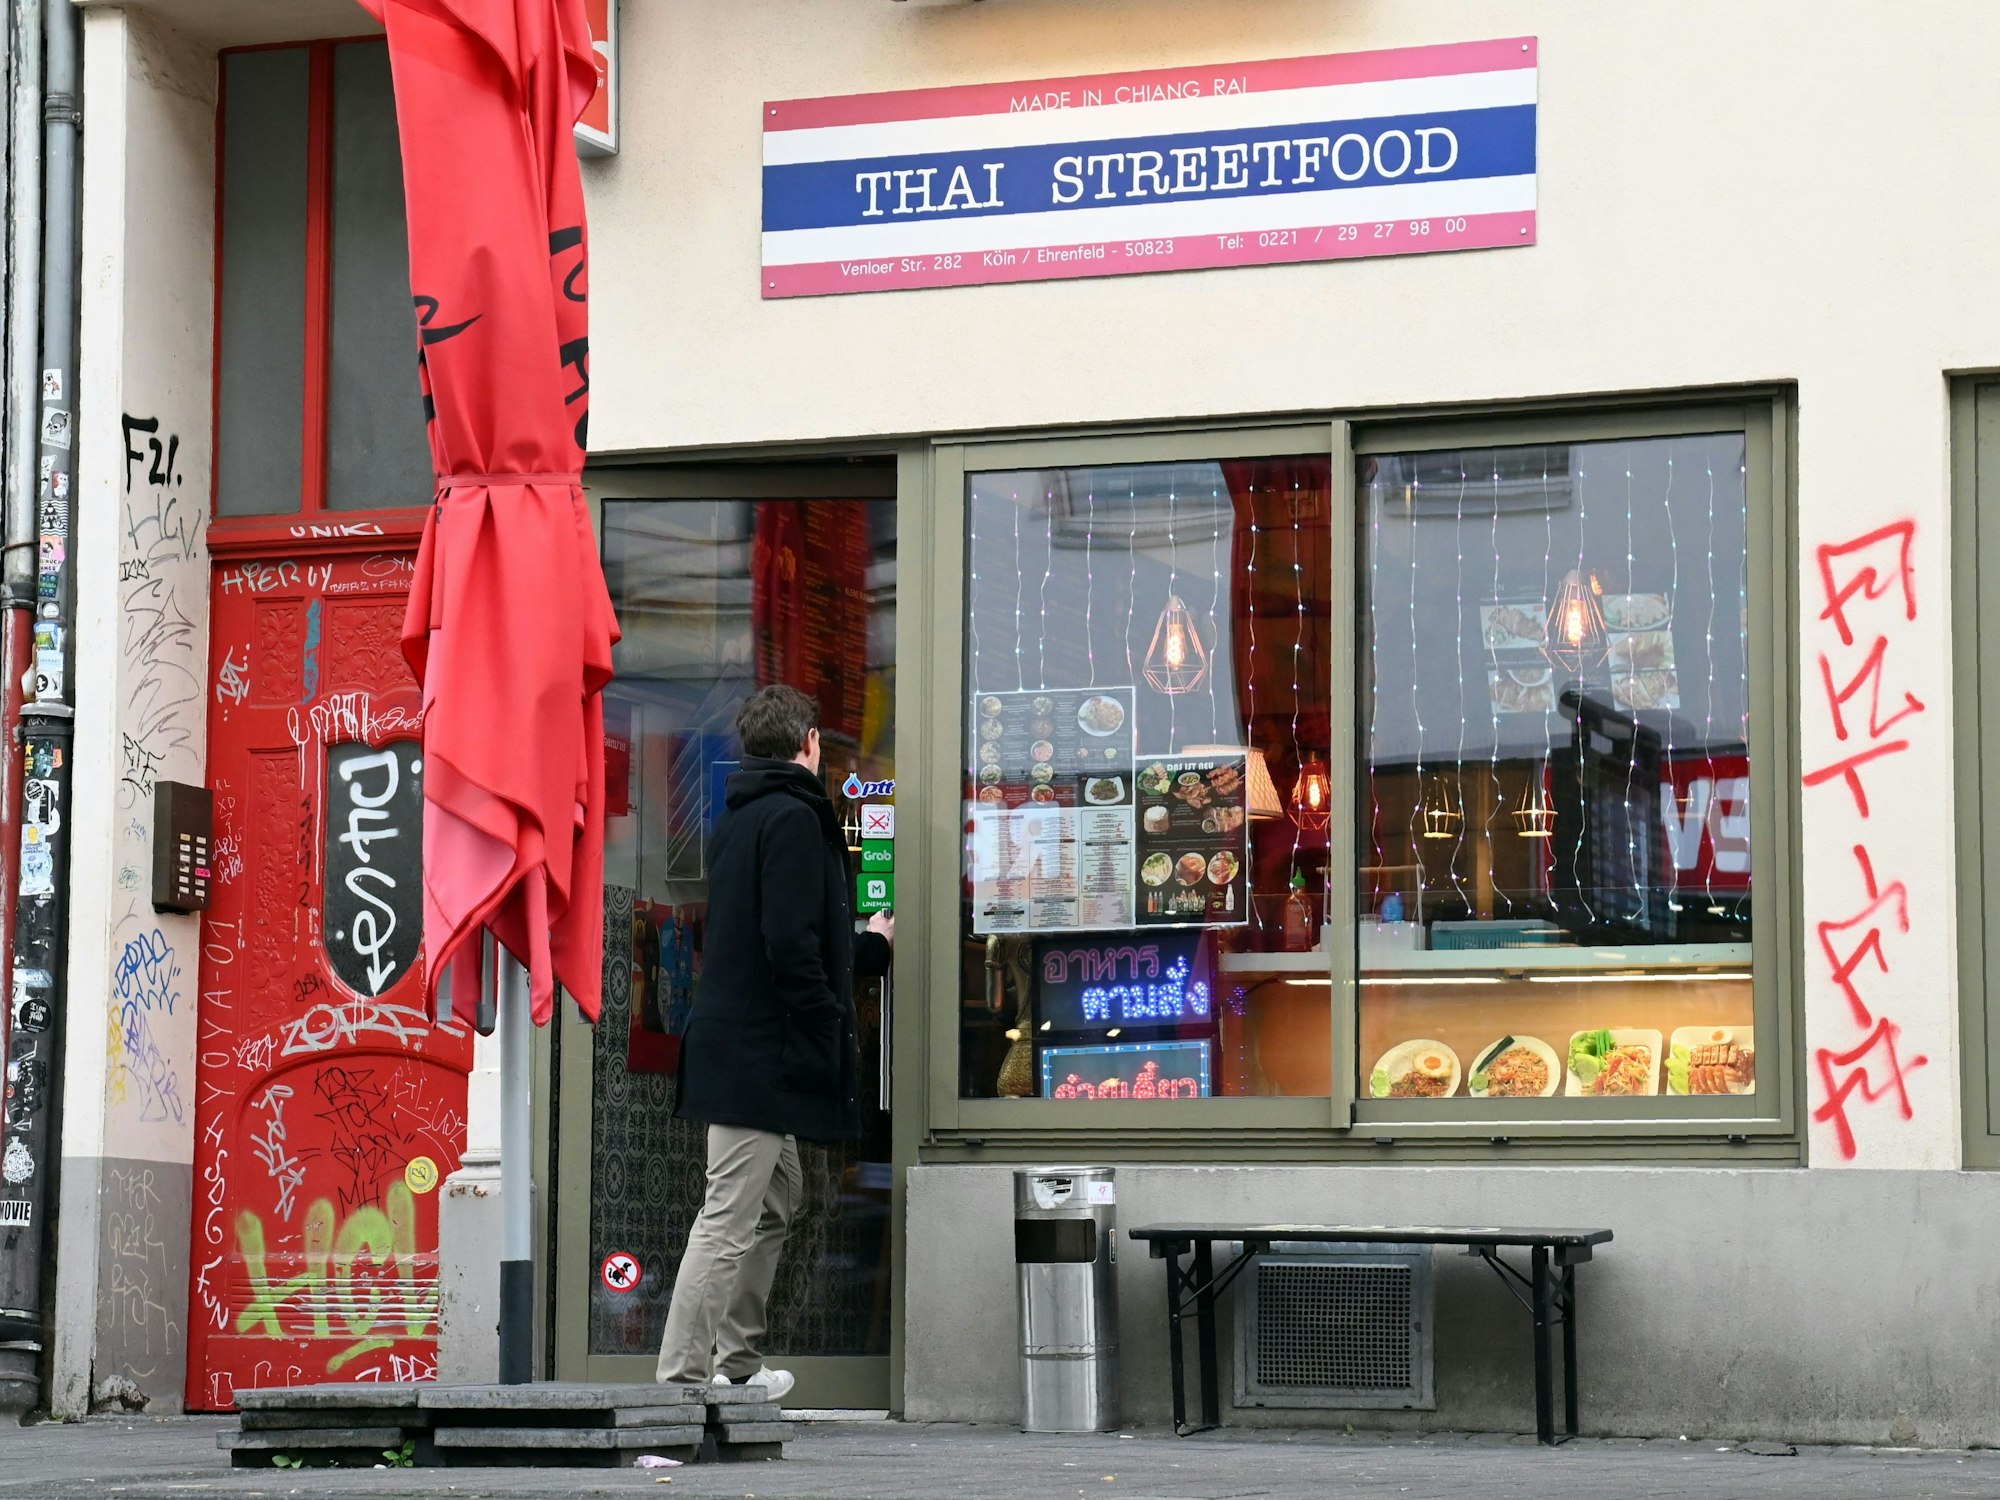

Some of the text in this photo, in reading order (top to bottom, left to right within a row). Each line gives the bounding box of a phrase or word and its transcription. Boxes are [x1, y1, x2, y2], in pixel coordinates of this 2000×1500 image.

[1009, 76, 1247, 113] MADE IN CHIANG RAI
[855, 126, 1459, 217] THAI STREETFOOD
[840, 260, 894, 276] Venloer
[900, 257, 926, 273] Str.
[933, 254, 963, 270] 282
[983, 249, 1016, 266] Köln
[1022, 250, 1030, 264] /
[1037, 243, 1105, 263] Ehrenfeld
[1125, 239, 1174, 256] 50823
[1217, 235, 1244, 250] Tel:
[1258, 231, 1298, 247] 0221
[1314, 228, 1323, 243] /
[1337, 226, 1358, 241] 29
[1373, 223, 1394, 239] 27
[1409, 220, 1430, 236] 98
[1445, 217, 1467, 233] 00
[1167, 763, 1182, 771] DAS
[1198, 762, 1214, 770] NEU
[863, 850, 892, 861] Grab
[1042, 945, 1160, 984] อาหาร
[1082, 955, 1209, 1020] ตามสั่ง
